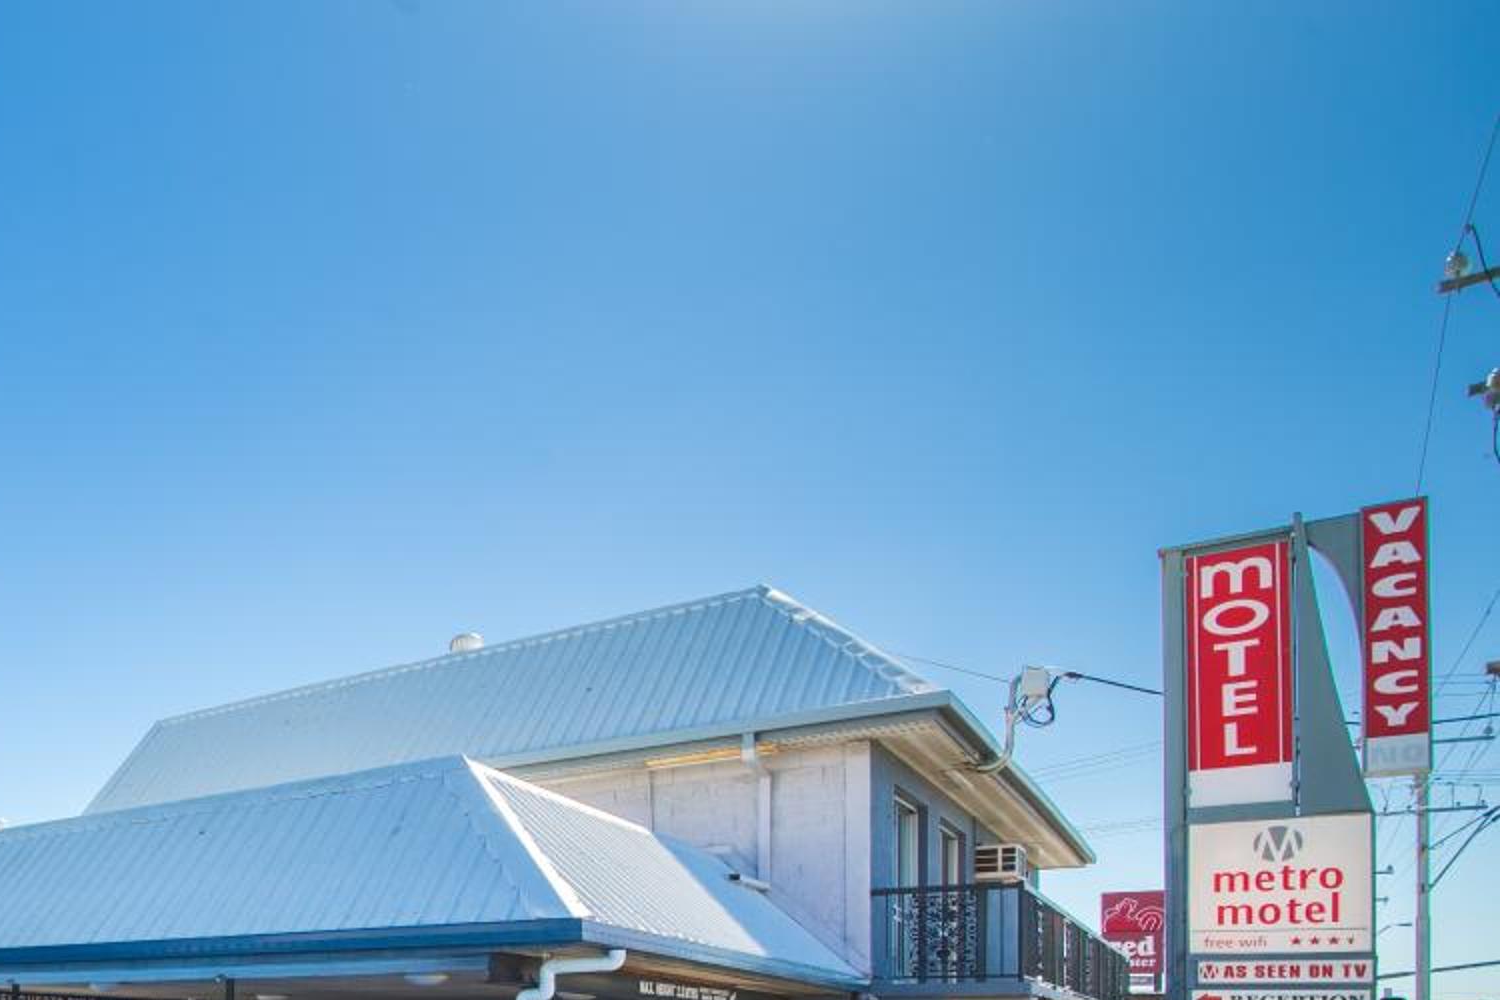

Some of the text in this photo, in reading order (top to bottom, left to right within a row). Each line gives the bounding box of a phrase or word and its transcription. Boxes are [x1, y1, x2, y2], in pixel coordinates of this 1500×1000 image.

[1369, 506, 1421, 726] VACANCY
[1200, 555, 1272, 757] MOTEL
[1213, 865, 1343, 893] metro
[1217, 892, 1340, 925] motel
[1204, 935, 1267, 949] free wifi
[1223, 964, 1247, 979] AS
[1254, 964, 1301, 979] SEEN
[1309, 963, 1334, 978] ON
[1343, 963, 1367, 977] TV
